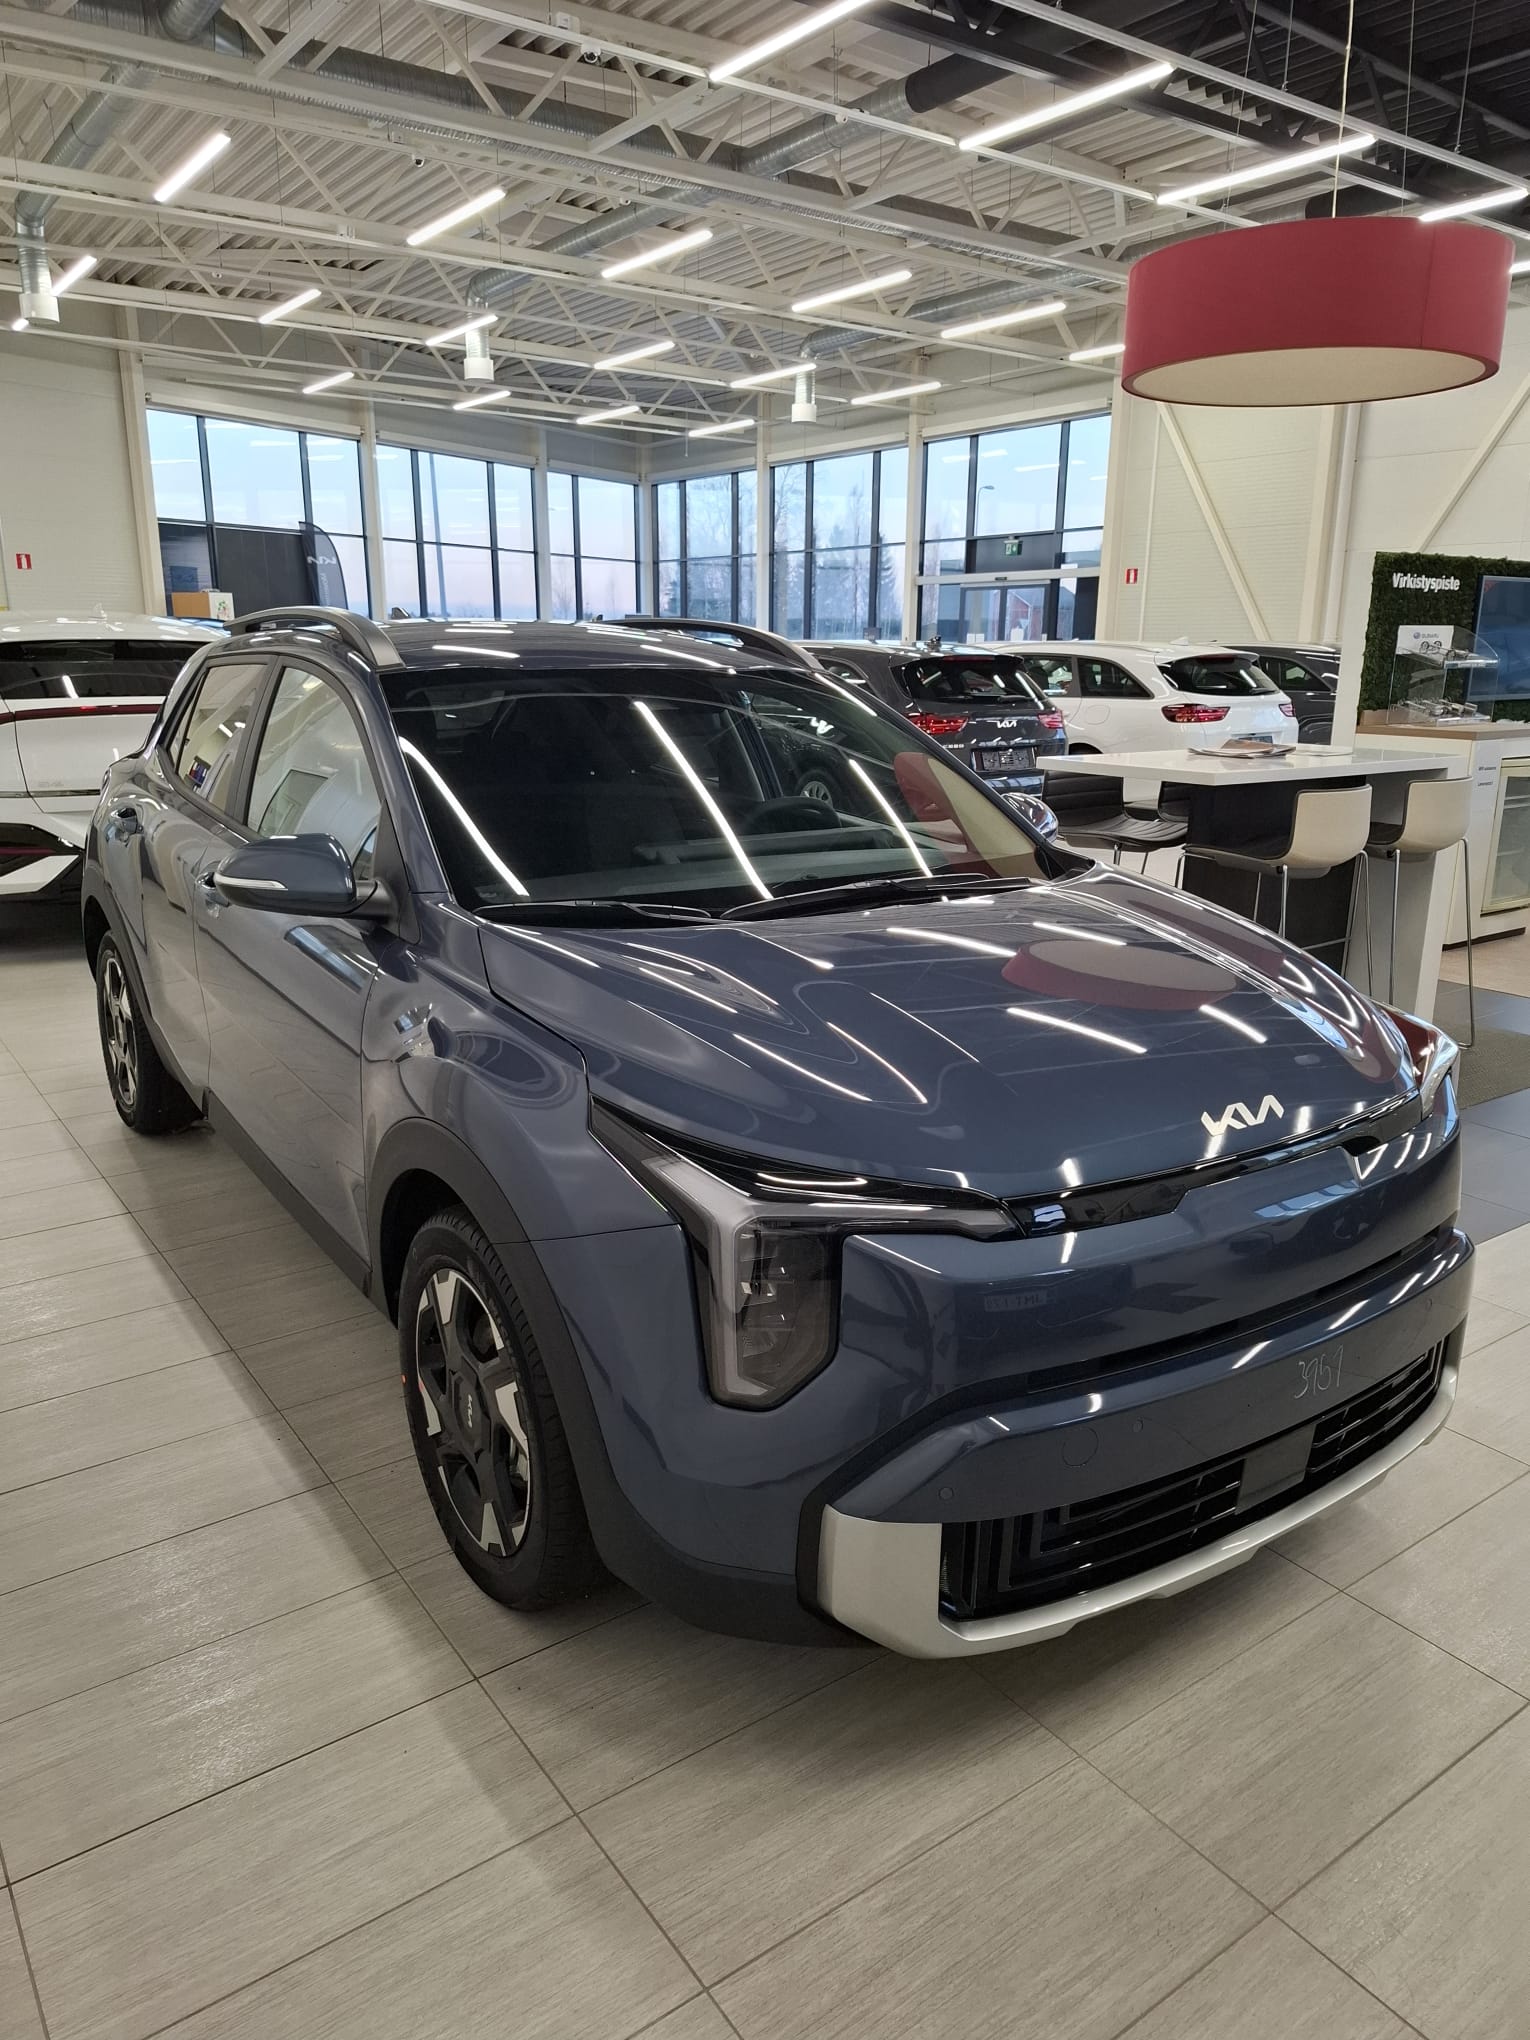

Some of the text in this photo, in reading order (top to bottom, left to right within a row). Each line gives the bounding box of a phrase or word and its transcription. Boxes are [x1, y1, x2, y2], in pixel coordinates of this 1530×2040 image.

[1392, 572, 1461, 593] Virkistyspiste
[996, 719, 1018, 729] KIA
[1201, 1094, 1284, 1137] KIA
